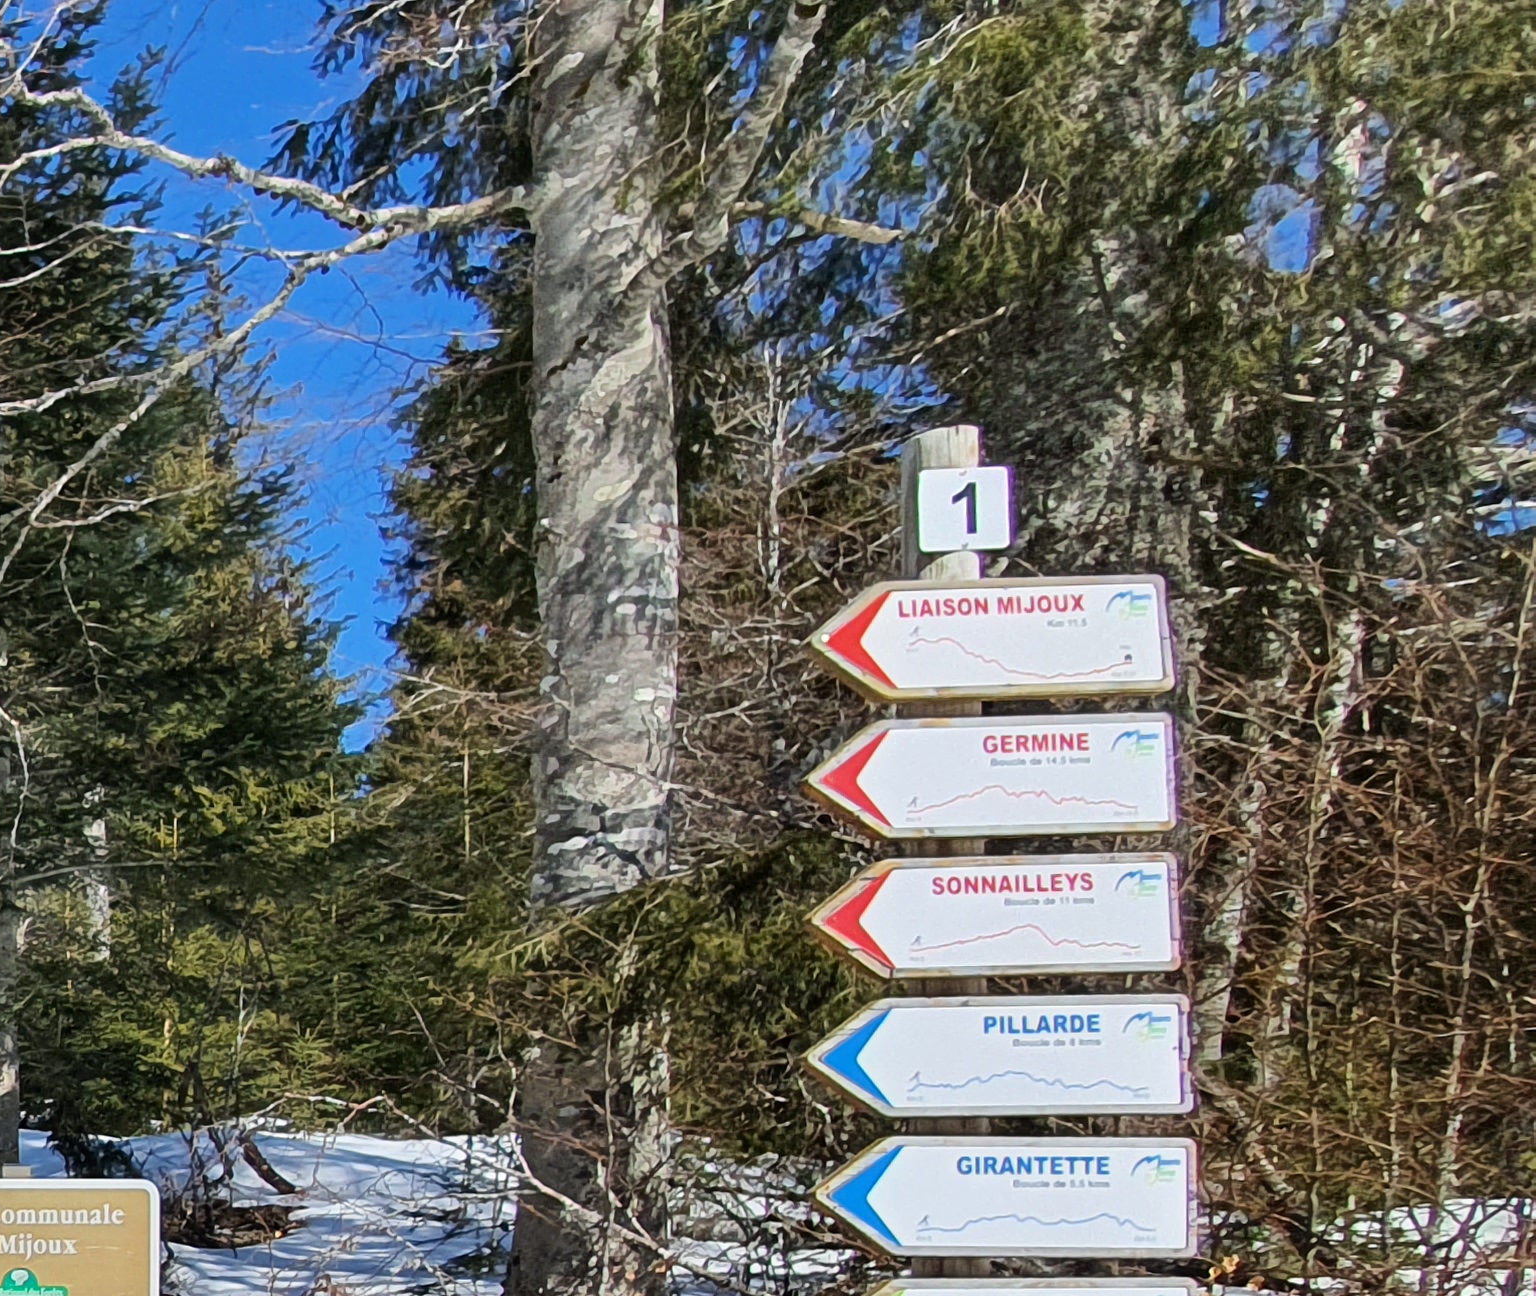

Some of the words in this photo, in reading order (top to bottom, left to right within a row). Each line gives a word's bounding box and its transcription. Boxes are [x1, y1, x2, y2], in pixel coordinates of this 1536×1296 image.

[951, 482, 978, 534] 1
[898, 597, 989, 618] LIAISON
[997, 594, 1085, 616] MIJOUX
[982, 733, 1090, 754] GERMINE
[990, 757, 1027, 766] Boucle
[1029, 757, 1042, 765] de
[932, 872, 1094, 895] SONNAILLEYS
[1003, 897, 1040, 906] Boucle
[1043, 897, 1056, 906] de
[984, 1014, 1101, 1034] PILLARDE
[1012, 1038, 1050, 1047] Boucle
[1053, 1038, 1066, 1047] de
[956, 1156, 1110, 1176] GIRANTETTE
[1012, 1179, 1050, 1188] Boucle
[1053, 1179, 1067, 1188] de
